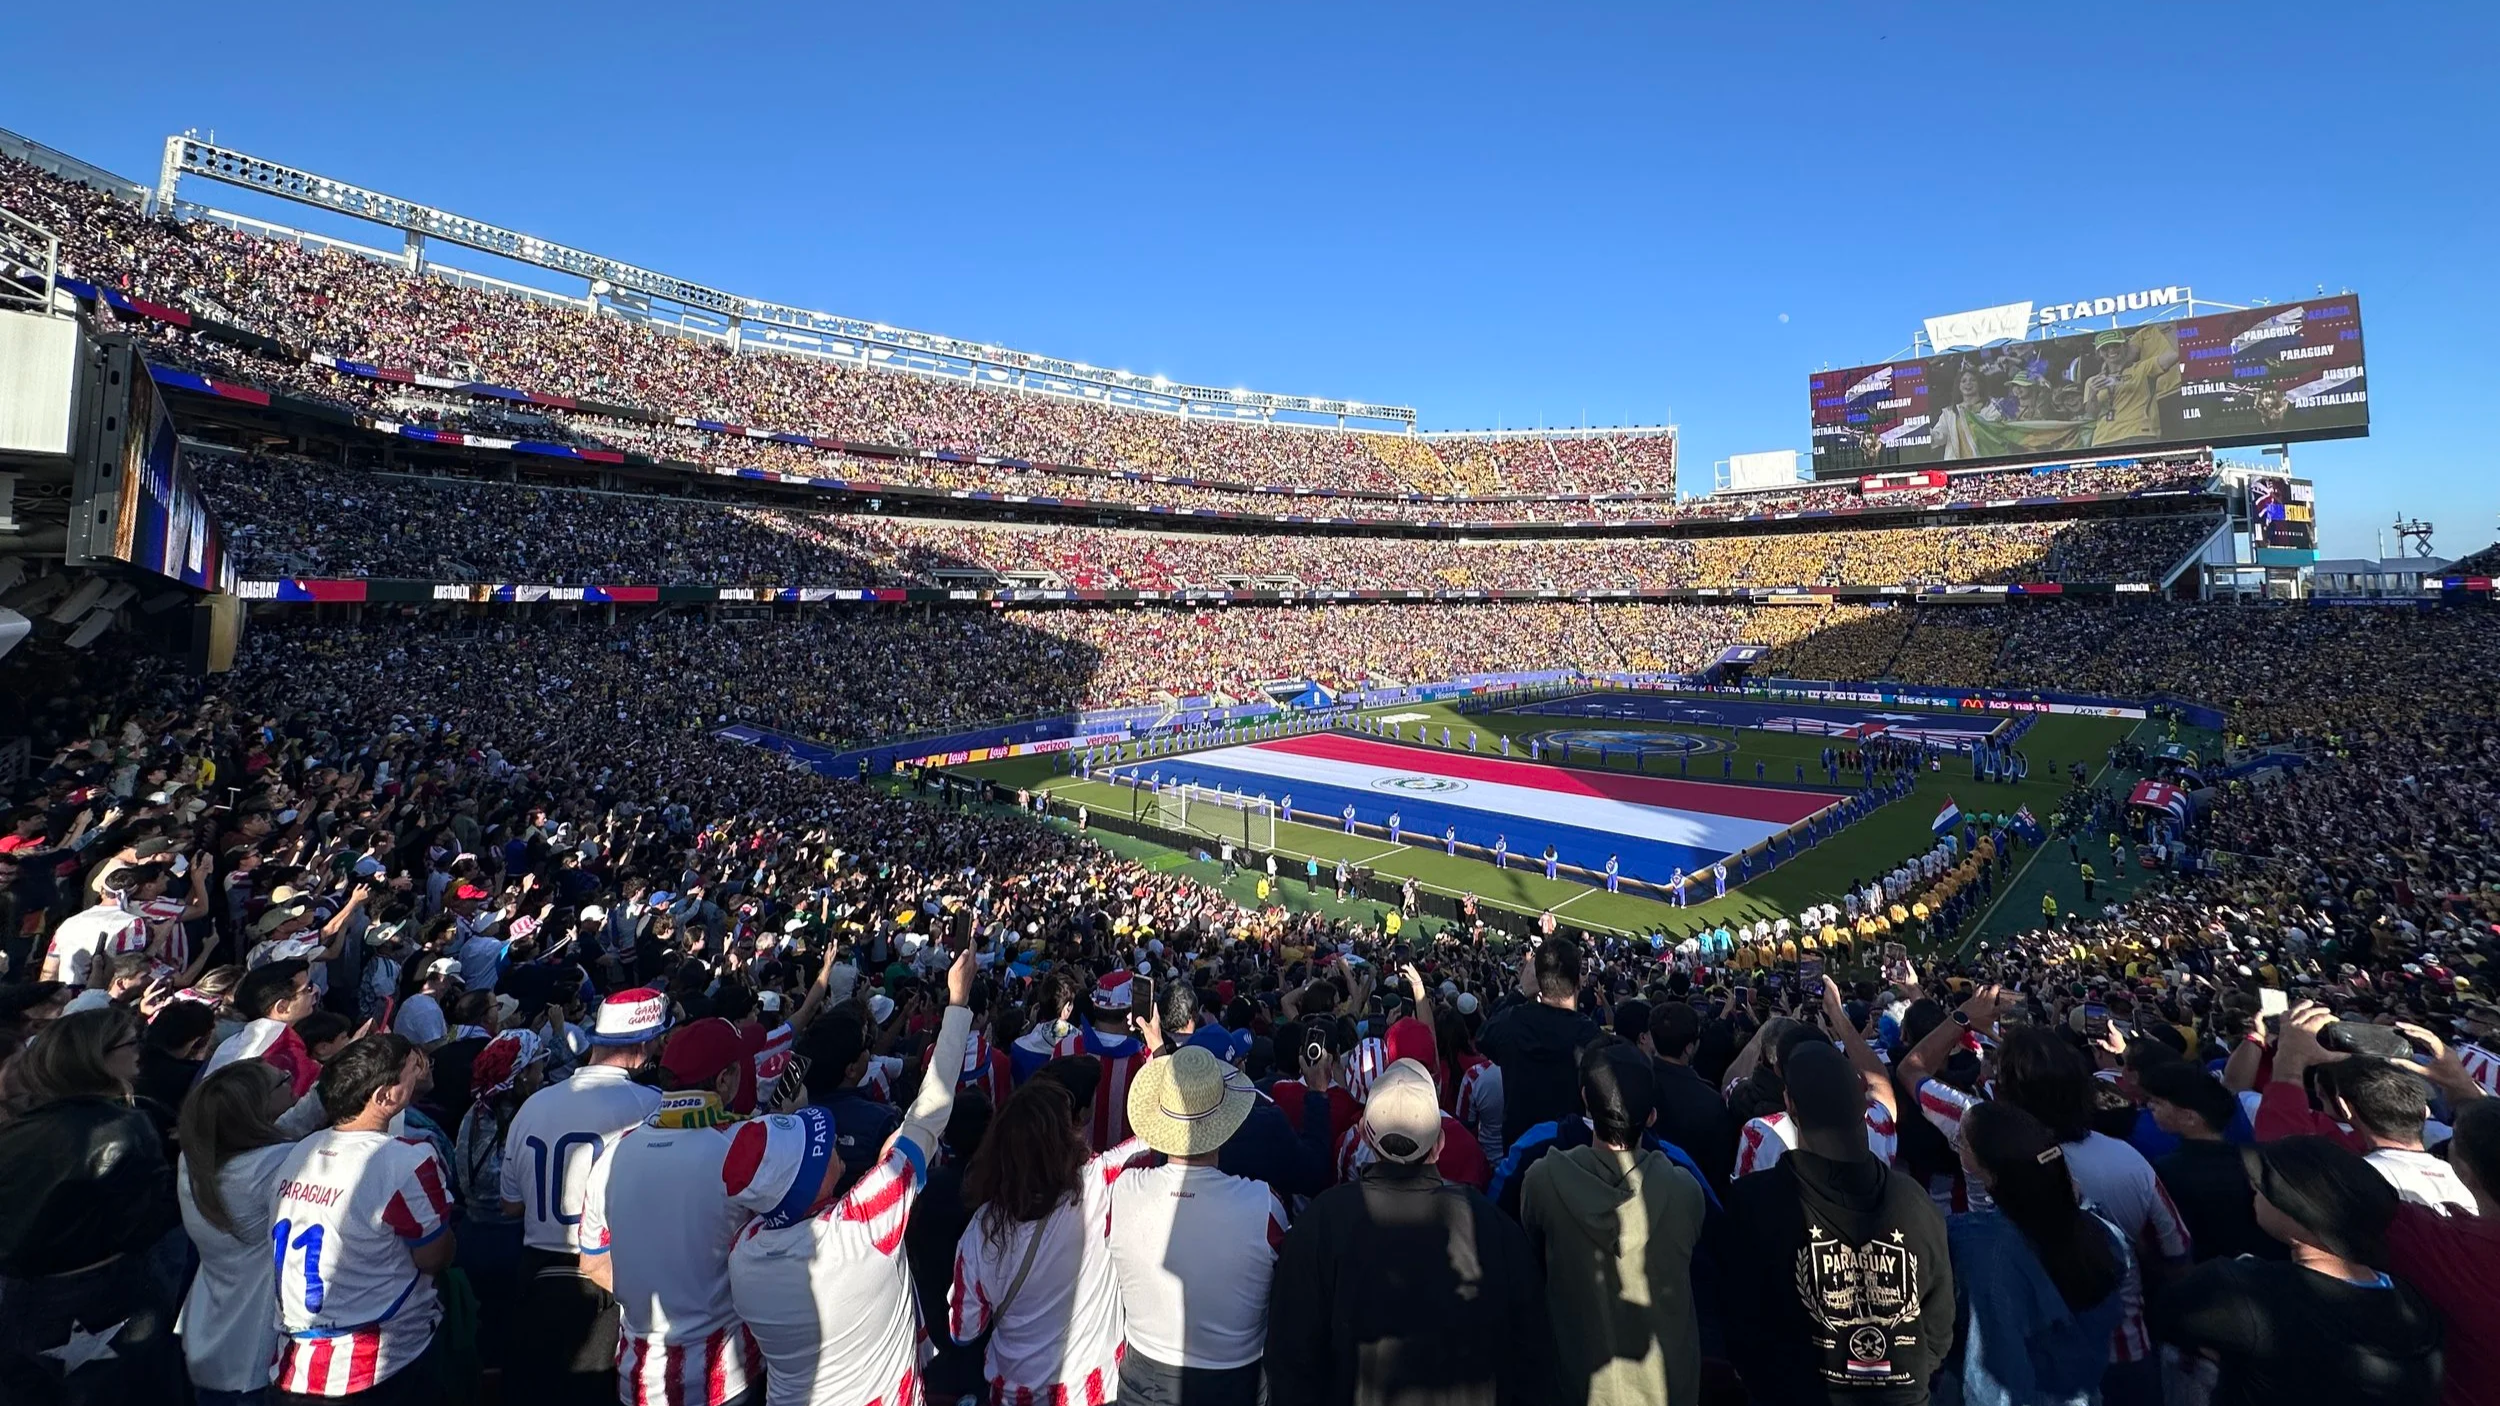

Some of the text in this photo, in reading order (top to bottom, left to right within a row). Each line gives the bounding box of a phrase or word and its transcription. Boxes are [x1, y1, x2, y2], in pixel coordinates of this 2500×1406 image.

[2039, 286, 2178, 325] STADIUM
[2244, 325, 2296, 342] PARAGUAY
[2280, 344, 2335, 361] PARAGUAY
[2322, 365, 2364, 380] AUSTRA
[1853, 381, 1887, 393] PARAGUAY
[2181, 382, 2226, 396] USTRALIA
[1876, 397, 1912, 410] PARAGUAY
[1903, 415, 1931, 427] AUSTRA
[433, 584, 470, 600] AUSTRALIA
[549, 587, 585, 600] PARAGUAY
[719, 588, 754, 600] AUSTRALIA
[835, 588, 863, 600] PARAGUAY
[2115, 583, 2150, 593] AUSTRALIA
[1434, 690, 1460, 700] Hisense
[2073, 705, 2102, 716] Dove
[1035, 724, 1047, 732] FIFA
[1182, 720, 1213, 733] ULTRA
[1033, 739, 1071, 753] verizon
[1085, 733, 1120, 746] verizon
[948, 751, 968, 765] Lay's
[989, 746, 1009, 759] Lay's
[672, 1098, 702, 1108] 2026
[526, 1131, 606, 1226] 10
[277, 1178, 344, 1208] PARAGUAY
[1170, 1191, 1195, 1199] PARAGUAY
[763, 1209, 790, 1229] UAY
[272, 1218, 325, 1314] 11
[1822, 1252, 1897, 1274] PARAGUAY
